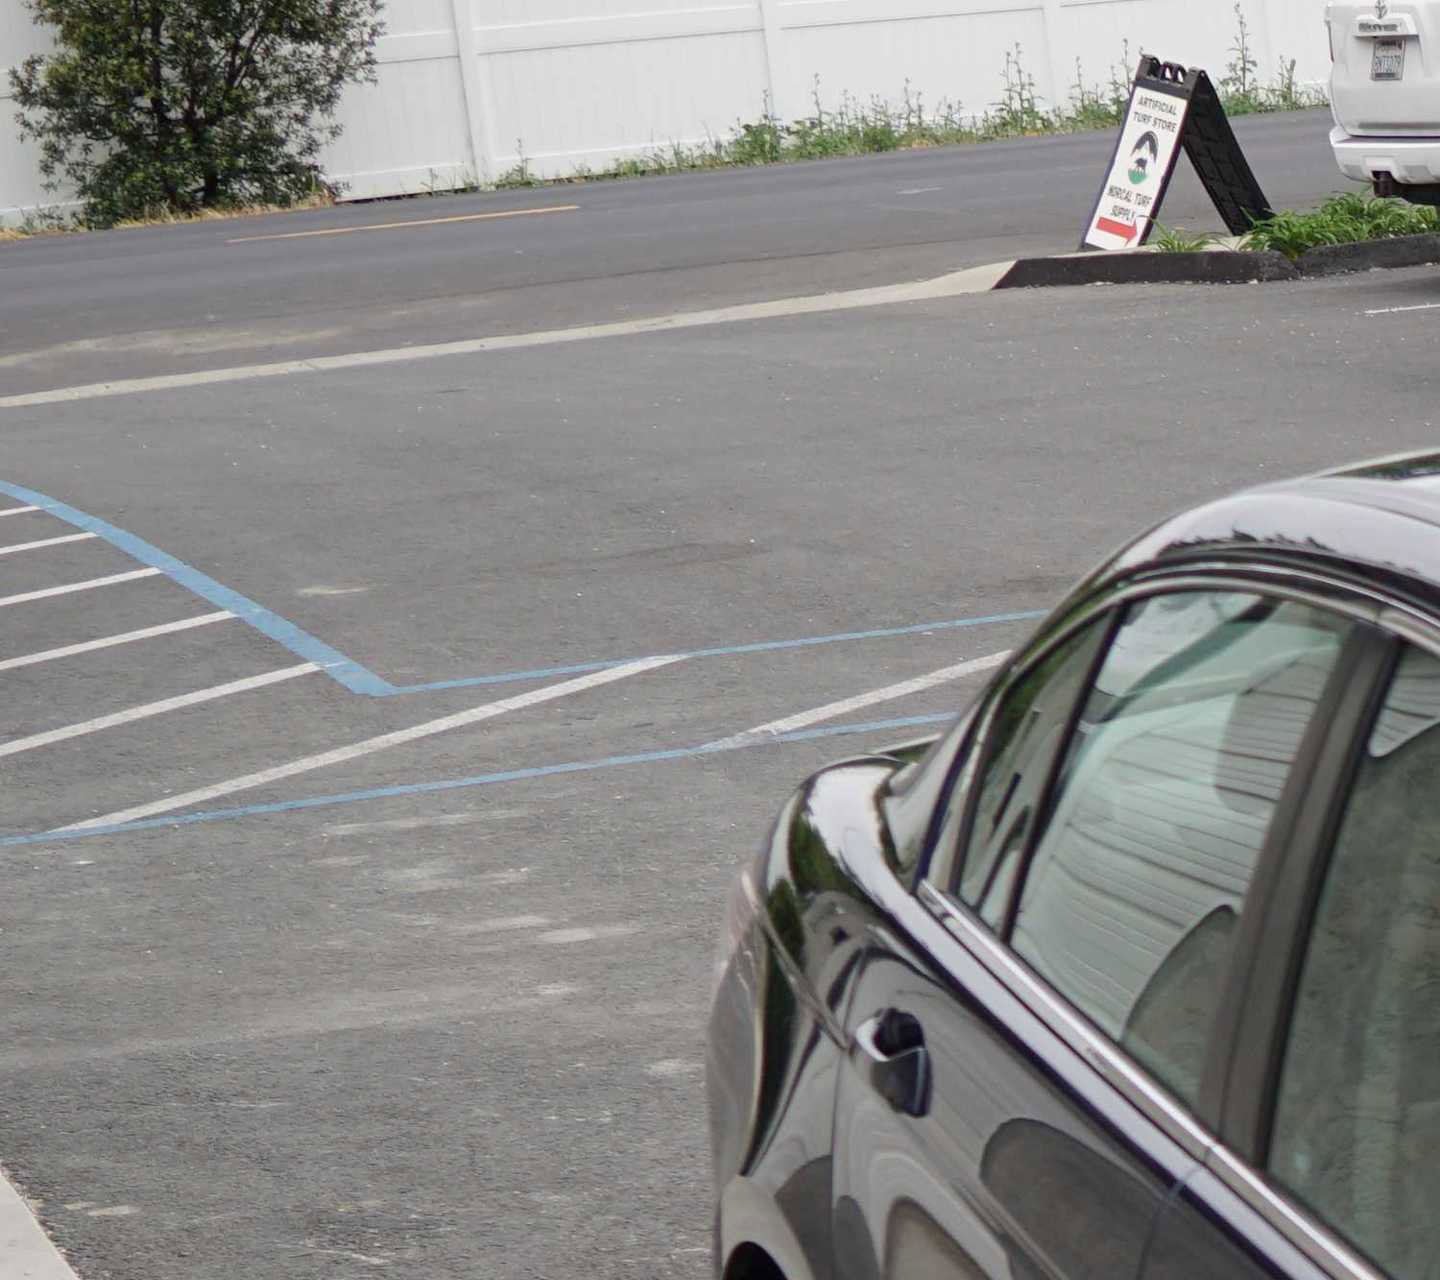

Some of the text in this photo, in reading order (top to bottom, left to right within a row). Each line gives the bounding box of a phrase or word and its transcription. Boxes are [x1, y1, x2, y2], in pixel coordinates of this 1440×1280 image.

[1137, 95, 1178, 116] ARTIFICIAL
[1133, 111, 1177, 133] TURF STORE
